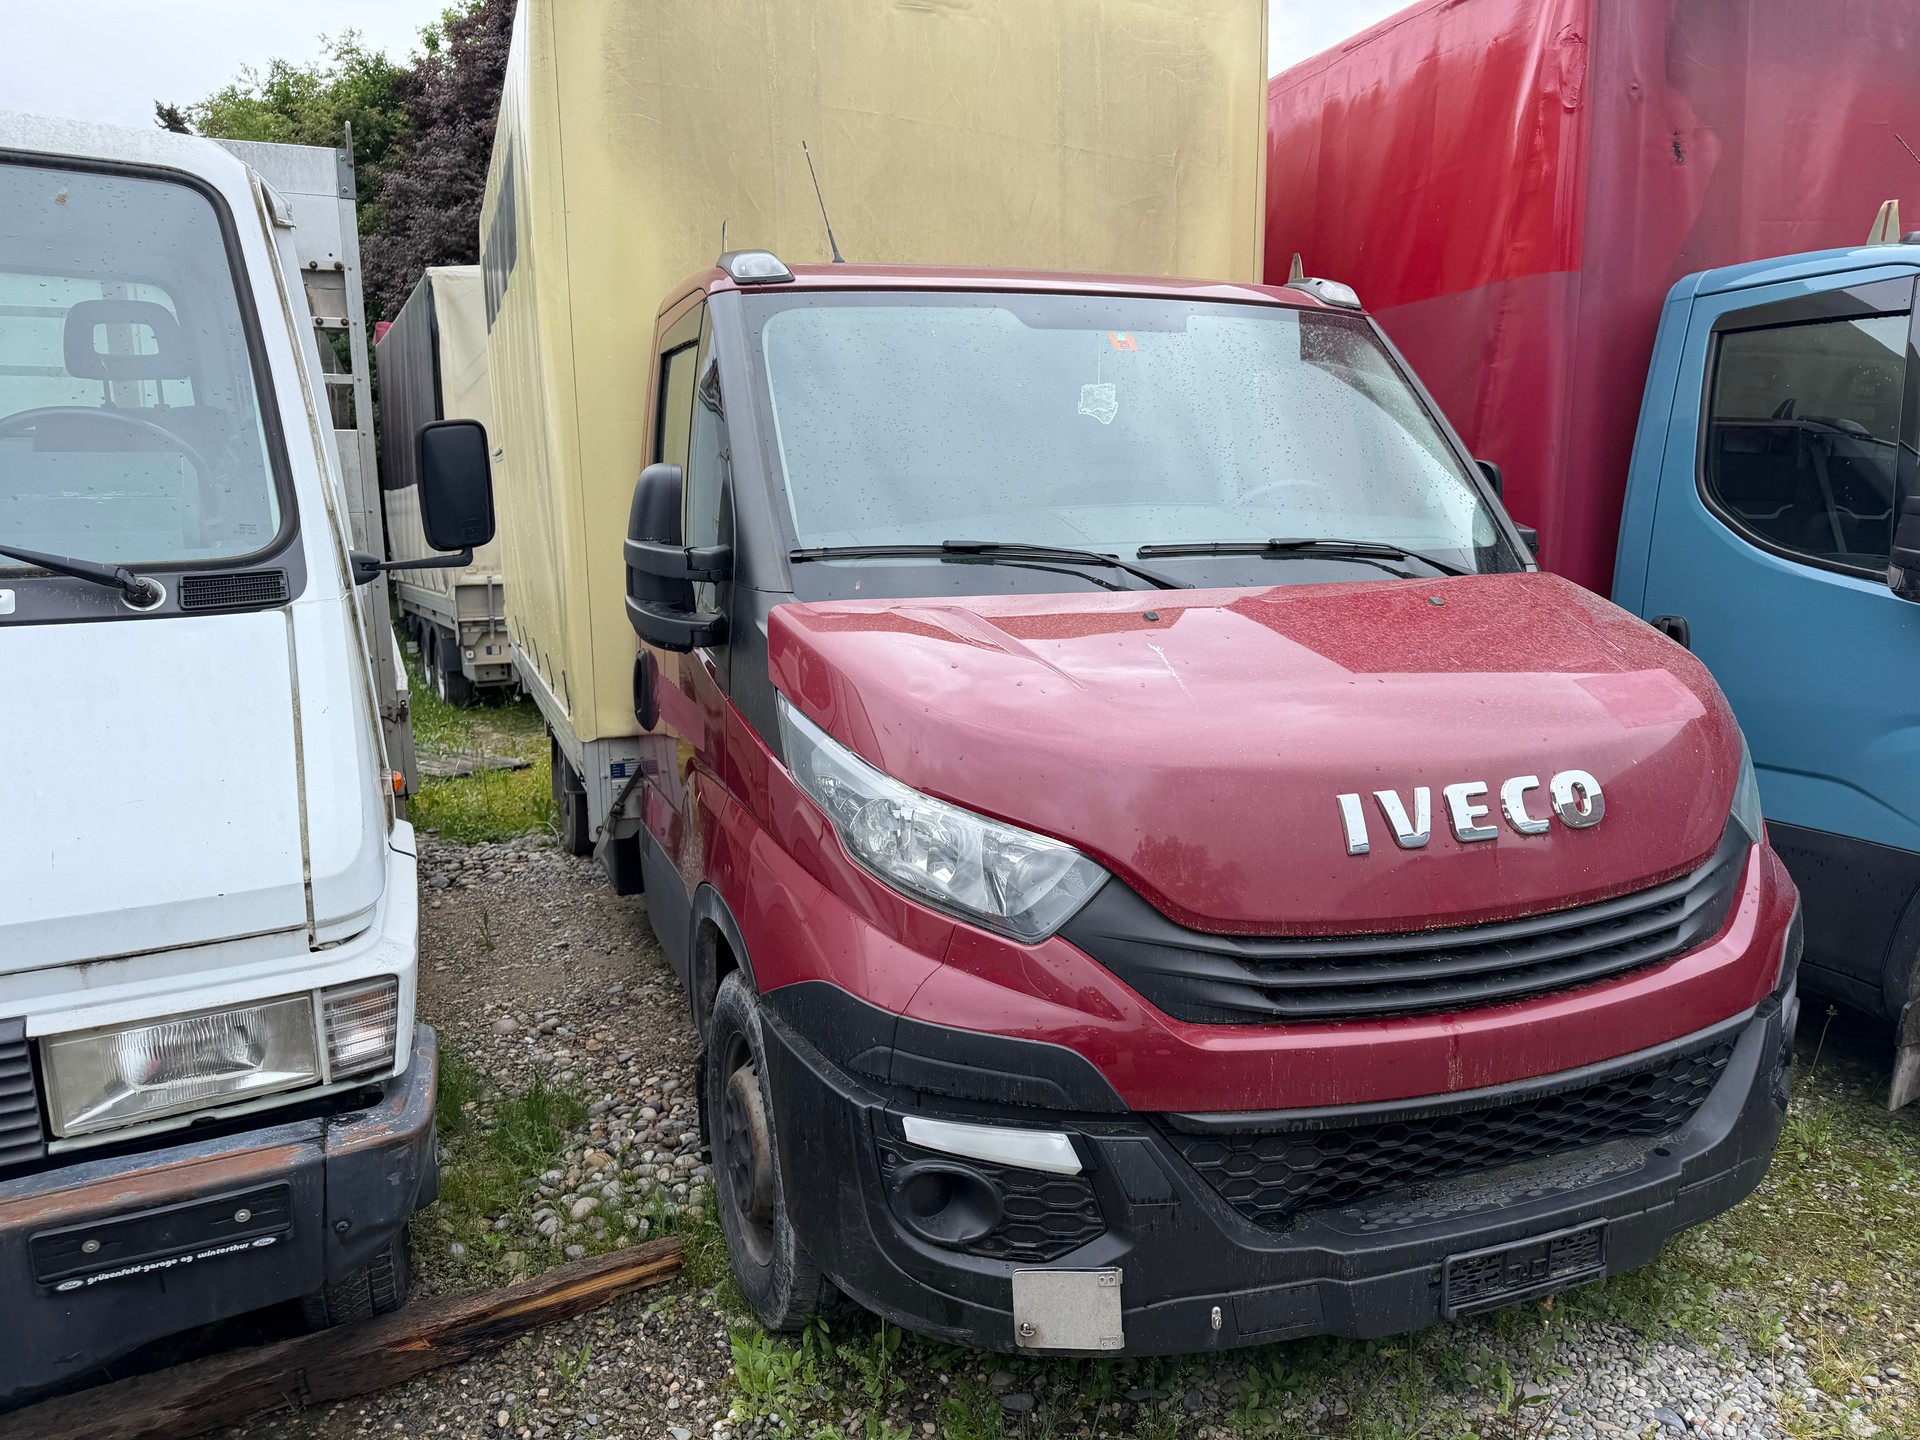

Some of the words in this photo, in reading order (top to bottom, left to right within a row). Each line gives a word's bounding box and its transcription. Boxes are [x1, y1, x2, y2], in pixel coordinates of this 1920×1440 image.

[1336, 769, 1606, 856] IVECO
[180, 1255, 193, 1263] ag
[197, 1242, 250, 1259] winterthur
